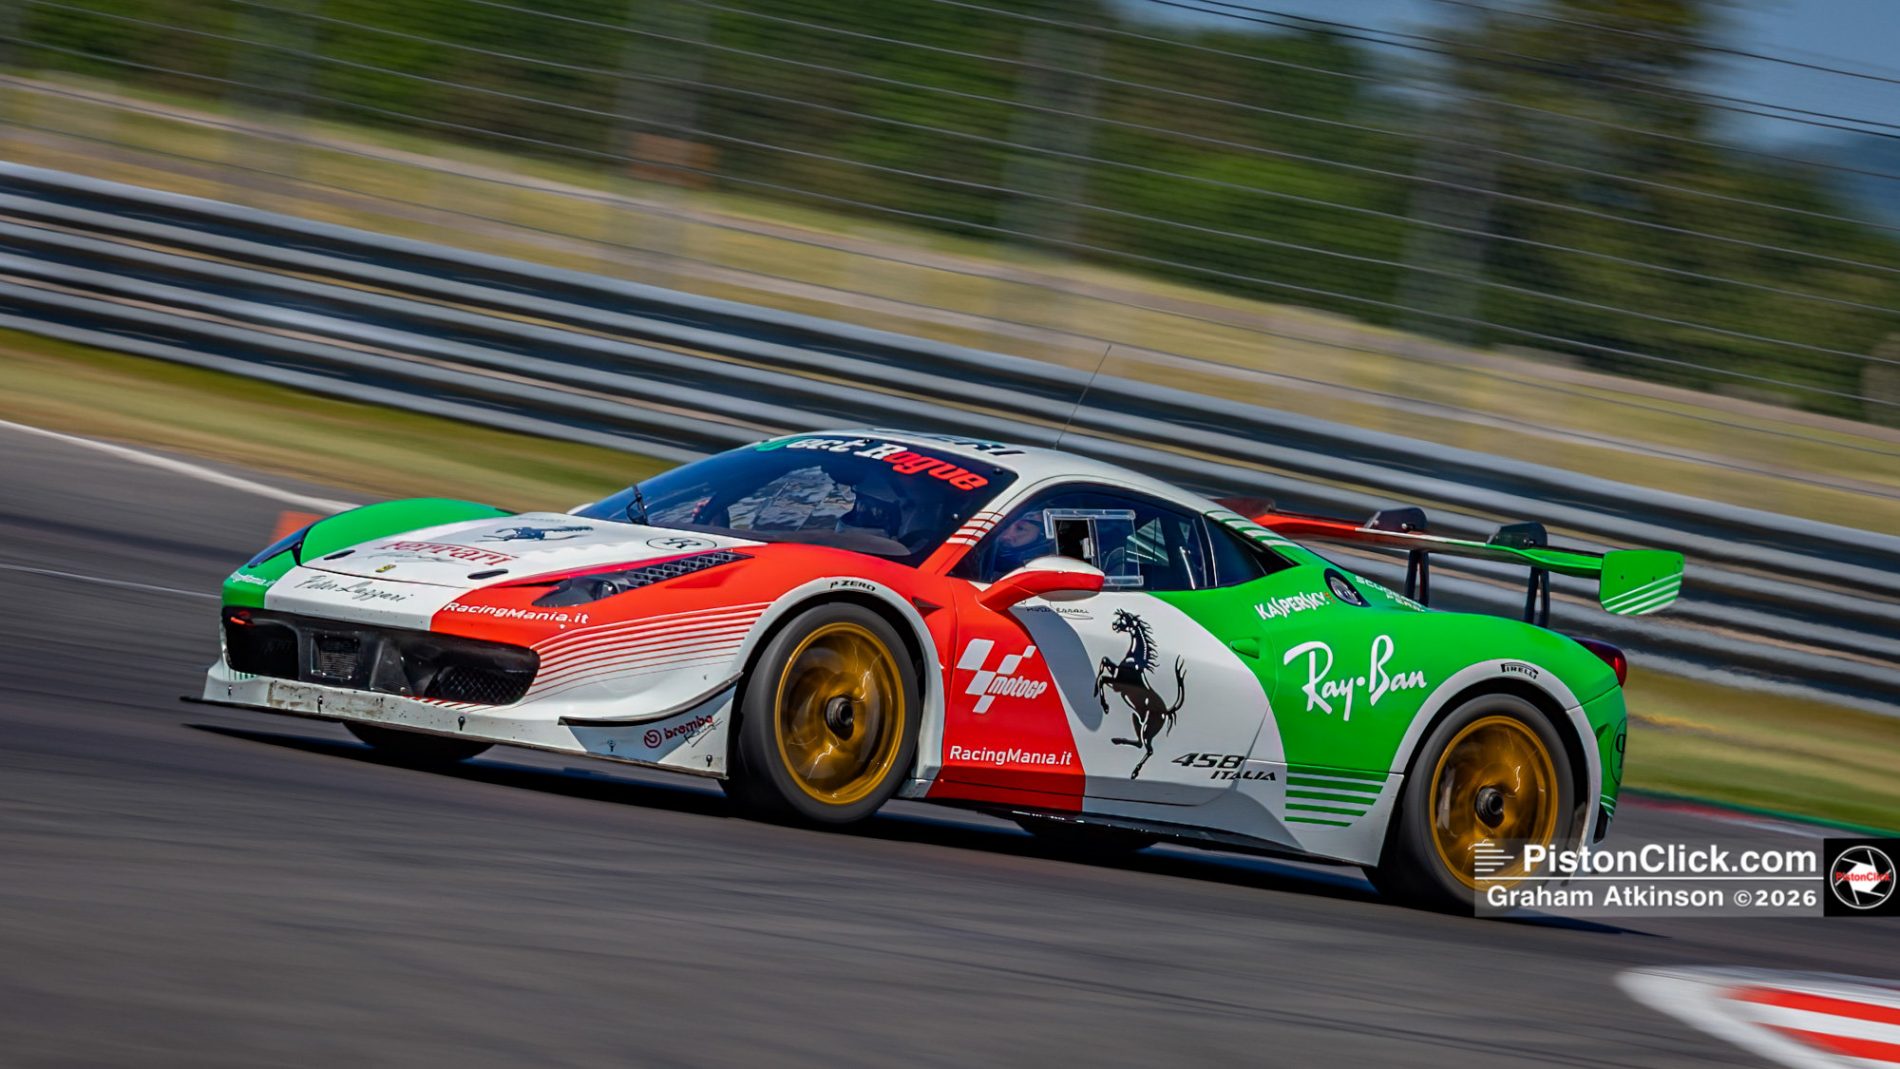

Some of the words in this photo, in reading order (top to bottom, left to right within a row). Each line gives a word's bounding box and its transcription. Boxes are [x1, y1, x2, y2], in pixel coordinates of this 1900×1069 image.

[854, 442, 989, 491] Rogue
[841, 579, 876, 592] ZERO
[443, 602, 590, 624] RacingMania.it
[1500, 661, 1539, 680] PIRELLI
[663, 714, 714, 740] brembo
[949, 745, 1073, 766] RacingMania.it
[1171, 752, 1246, 769] 458
[1210, 770, 1277, 782] ITALIA
